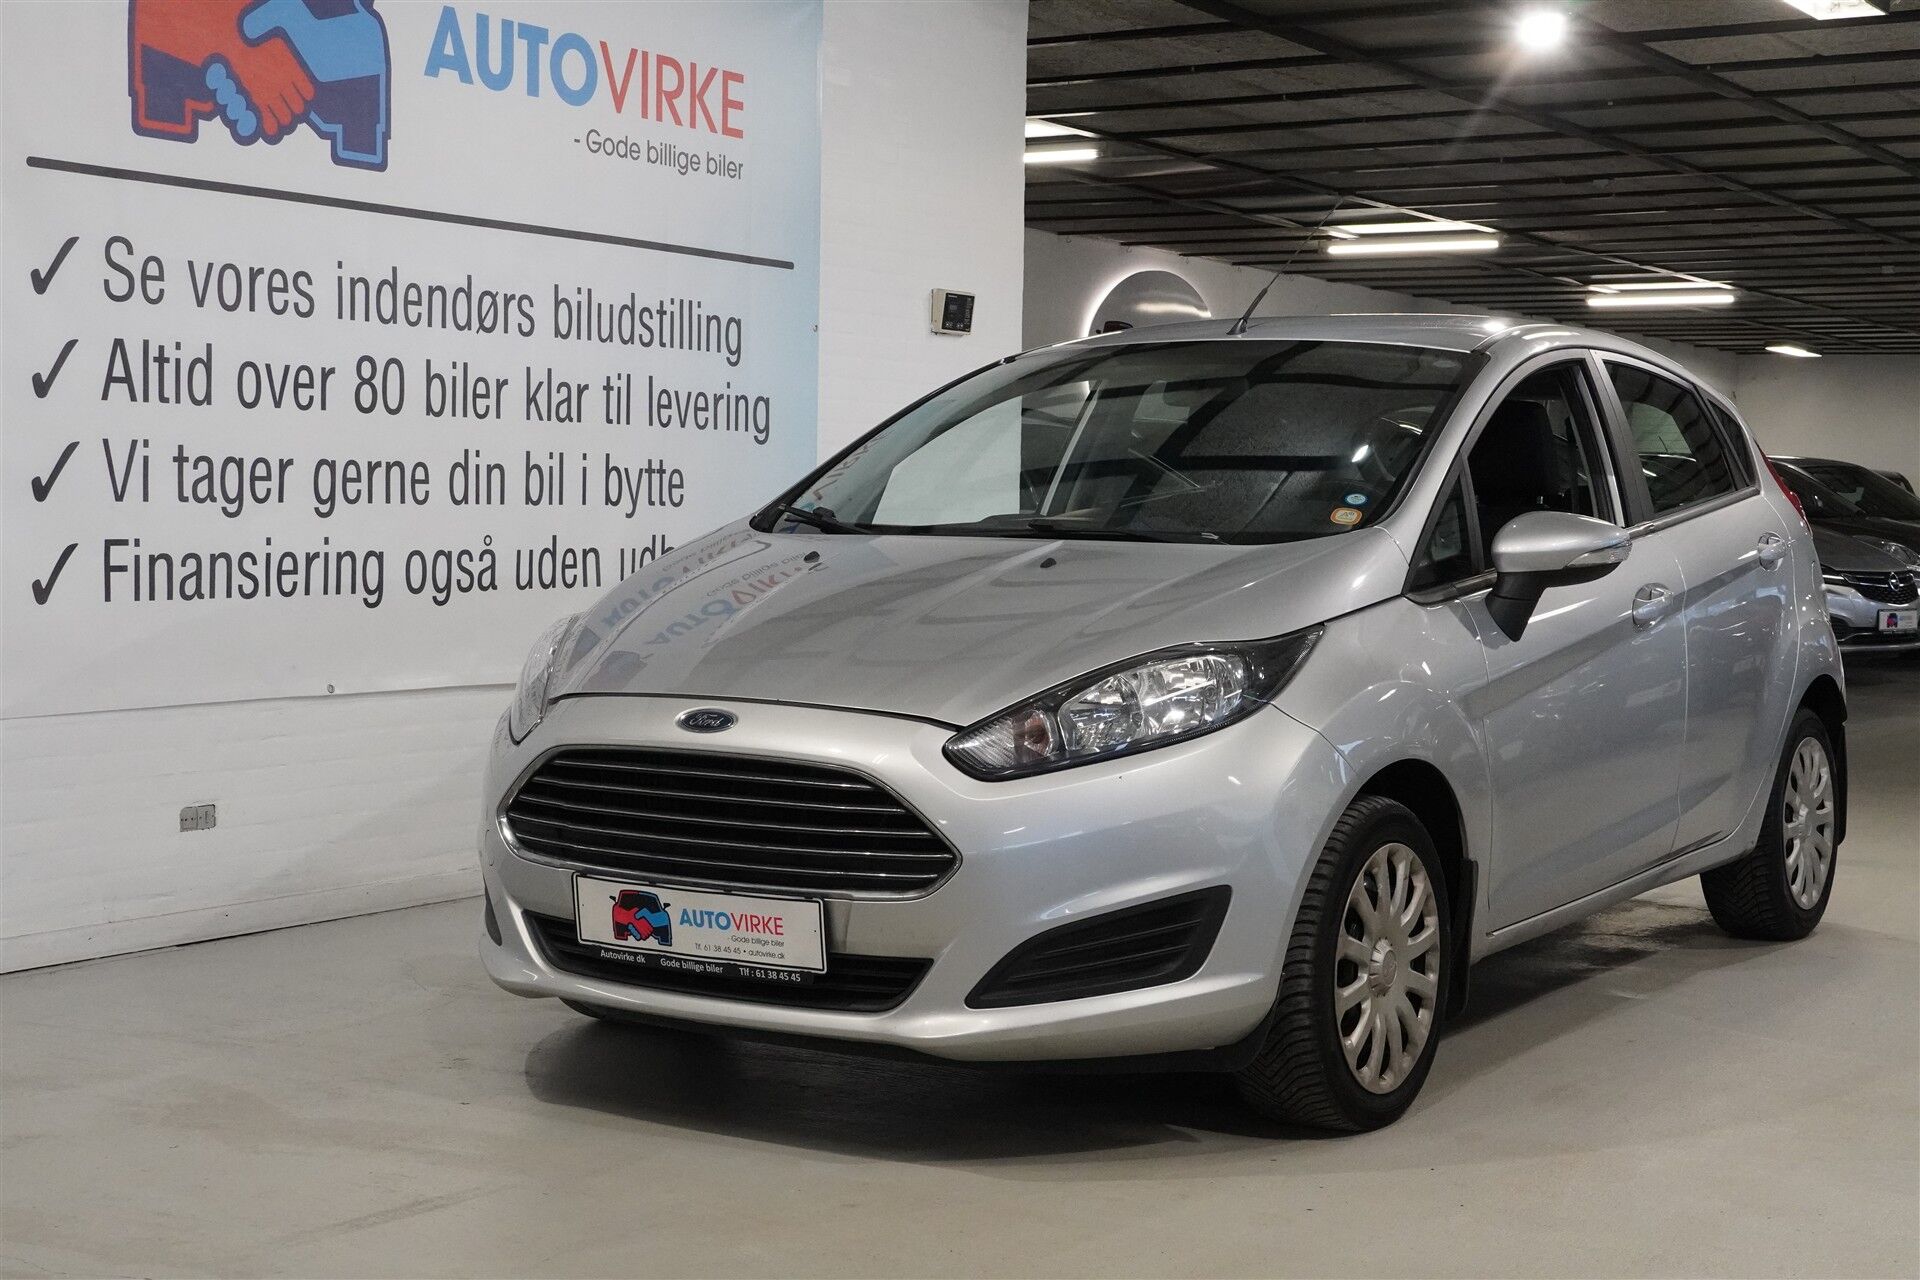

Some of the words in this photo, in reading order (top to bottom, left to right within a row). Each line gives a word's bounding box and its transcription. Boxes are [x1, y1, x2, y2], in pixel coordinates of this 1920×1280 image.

[424, 5, 744, 139] AUTOVIRKE
[586, 128, 641, 161] Gode
[646, 140, 701, 176] billige
[706, 151, 744, 180] biler
[103, 235, 165, 305] Se
[187, 260, 315, 318] vores
[337, 260, 535, 337] indendørs
[553, 283, 743, 367] biludstilling
[101, 338, 213, 406] Altid
[237, 361, 336, 411] over
[354, 355, 405, 415] 80
[425, 358, 509, 419] biler
[525, 366, 590, 423] klar
[602, 372, 632, 426] til
[648, 375, 770, 446] levering
[102, 438, 150, 503] Vi
[172, 444, 294, 519] tager
[313, 458, 430, 519] gerne
[448, 448, 506, 505] din
[524, 450, 565, 506] bil
[581, 452, 588, 506] i
[604, 453, 685, 519] bytte
[103, 536, 385, 609] Finansiering
[405, 534, 498, 606] også
[515, 534, 602, 591] uden
[619, 534, 675, 582] ud
[679, 908, 784, 936] AUTOVIRKE
[731, 934, 750, 944] Gode
[751, 938, 770, 947] billige
[771, 940, 785, 948] biler
[600, 949, 635, 962] Autovirke
[636, 953, 646, 964] dk
[660, 958, 680, 969] Gode
[682, 961, 704, 973] billige
[705, 964, 724, 974] biler
[703, 944, 712, 953] 61
[713, 944, 722, 953] 38
[723, 945, 732, 954] 45
[733, 947, 742, 955] 45
[748, 949, 785, 959] autovirke.dk
[756, 969, 766, 979] 61
[768, 971, 778, 980] 38
[779, 972, 789, 981] 45
[790, 973, 801, 983] 45
